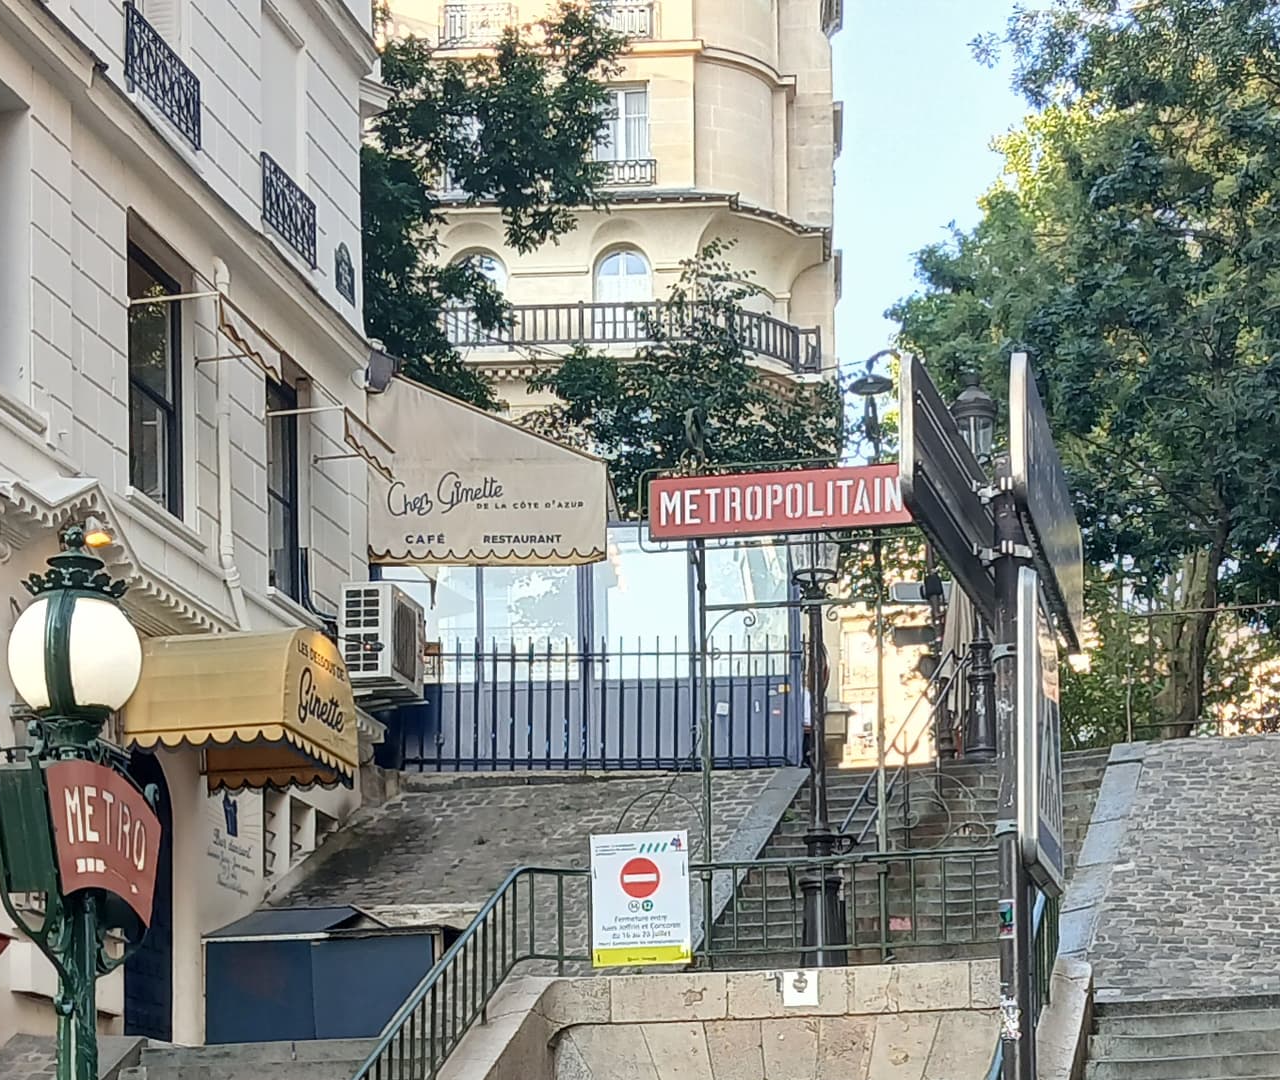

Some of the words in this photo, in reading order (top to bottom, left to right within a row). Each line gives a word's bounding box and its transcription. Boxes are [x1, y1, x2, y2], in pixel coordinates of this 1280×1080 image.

[387, 481, 433, 517] Chez
[437, 471, 504, 514] Ginette
[476, 502, 489, 510] DE
[495, 502, 507, 510] LA
[513, 499, 540, 510] CÔTE
[659, 475, 905, 528] METROPOLITAIN
[405, 532, 446, 545] CAFÉ
[483, 534, 562, 545] RESTAURANT
[298, 667, 345, 734] Ginette
[63, 785, 147, 871] METRO
